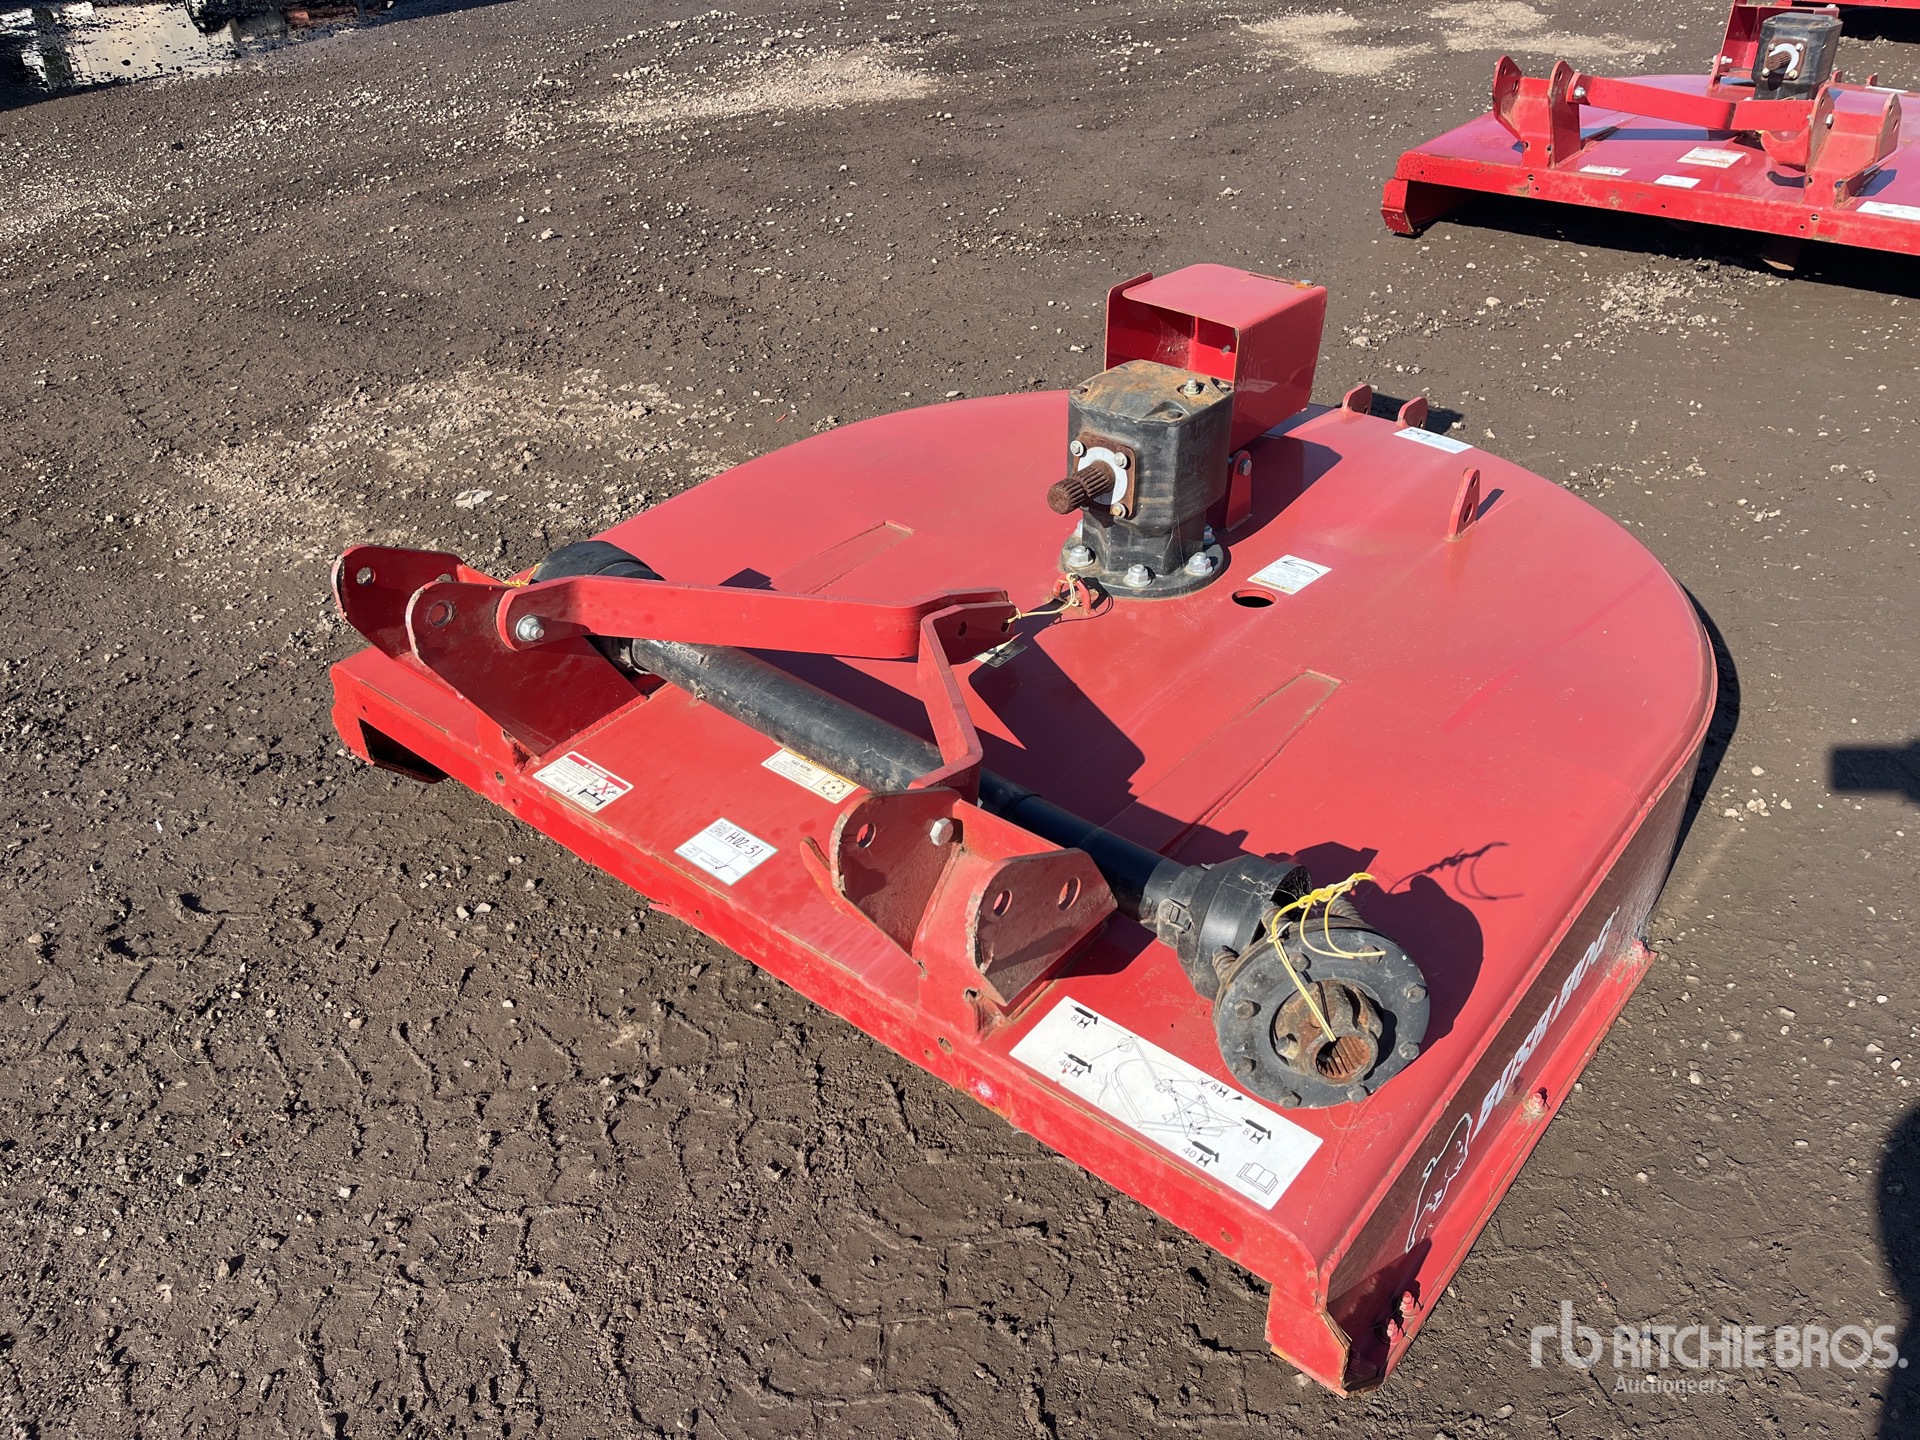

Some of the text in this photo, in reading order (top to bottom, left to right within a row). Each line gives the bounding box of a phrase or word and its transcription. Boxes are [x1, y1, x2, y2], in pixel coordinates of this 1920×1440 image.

[588, 764, 609, 779] DANGER
[1070, 1014, 1079, 1022] 8
[1470, 906, 1620, 1143] BUSH HOG
[1210, 1082, 1219, 1091] 8
[1242, 1127, 1251, 1136] 8
[1182, 1146, 1198, 1158] 40
